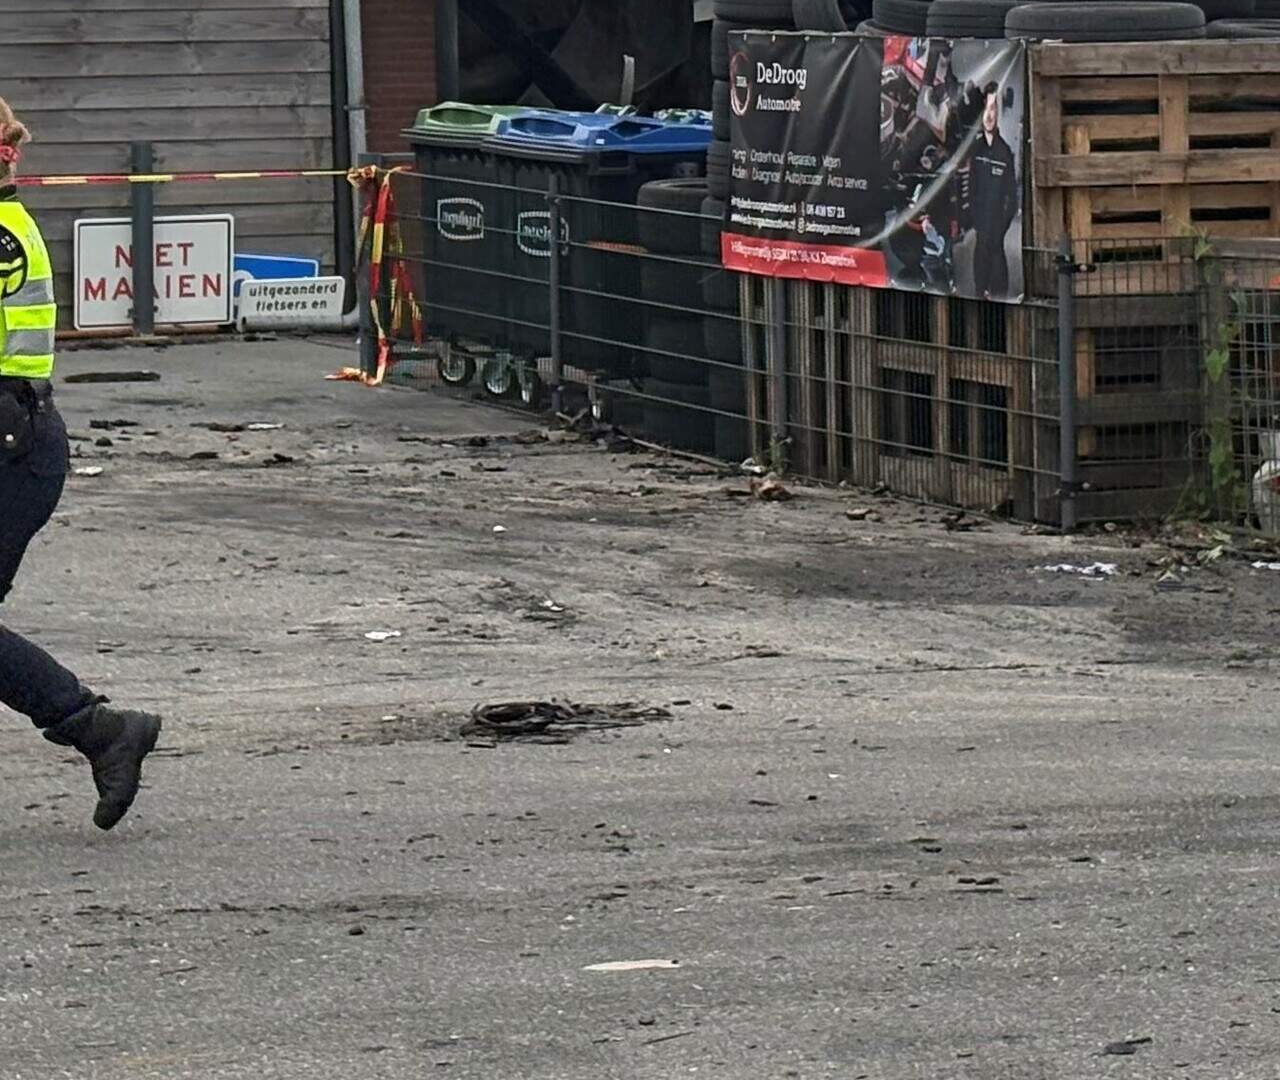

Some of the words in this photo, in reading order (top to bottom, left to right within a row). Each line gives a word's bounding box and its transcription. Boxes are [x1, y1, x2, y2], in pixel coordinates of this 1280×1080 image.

[756, 61, 808, 90] DeDroog
[115, 242, 194, 268] NET
[83, 273, 221, 301] MAIEN
[249, 282, 338, 299] uitgezonderd
[256, 299, 307, 312] fietsers
[311, 299, 328, 309] en
